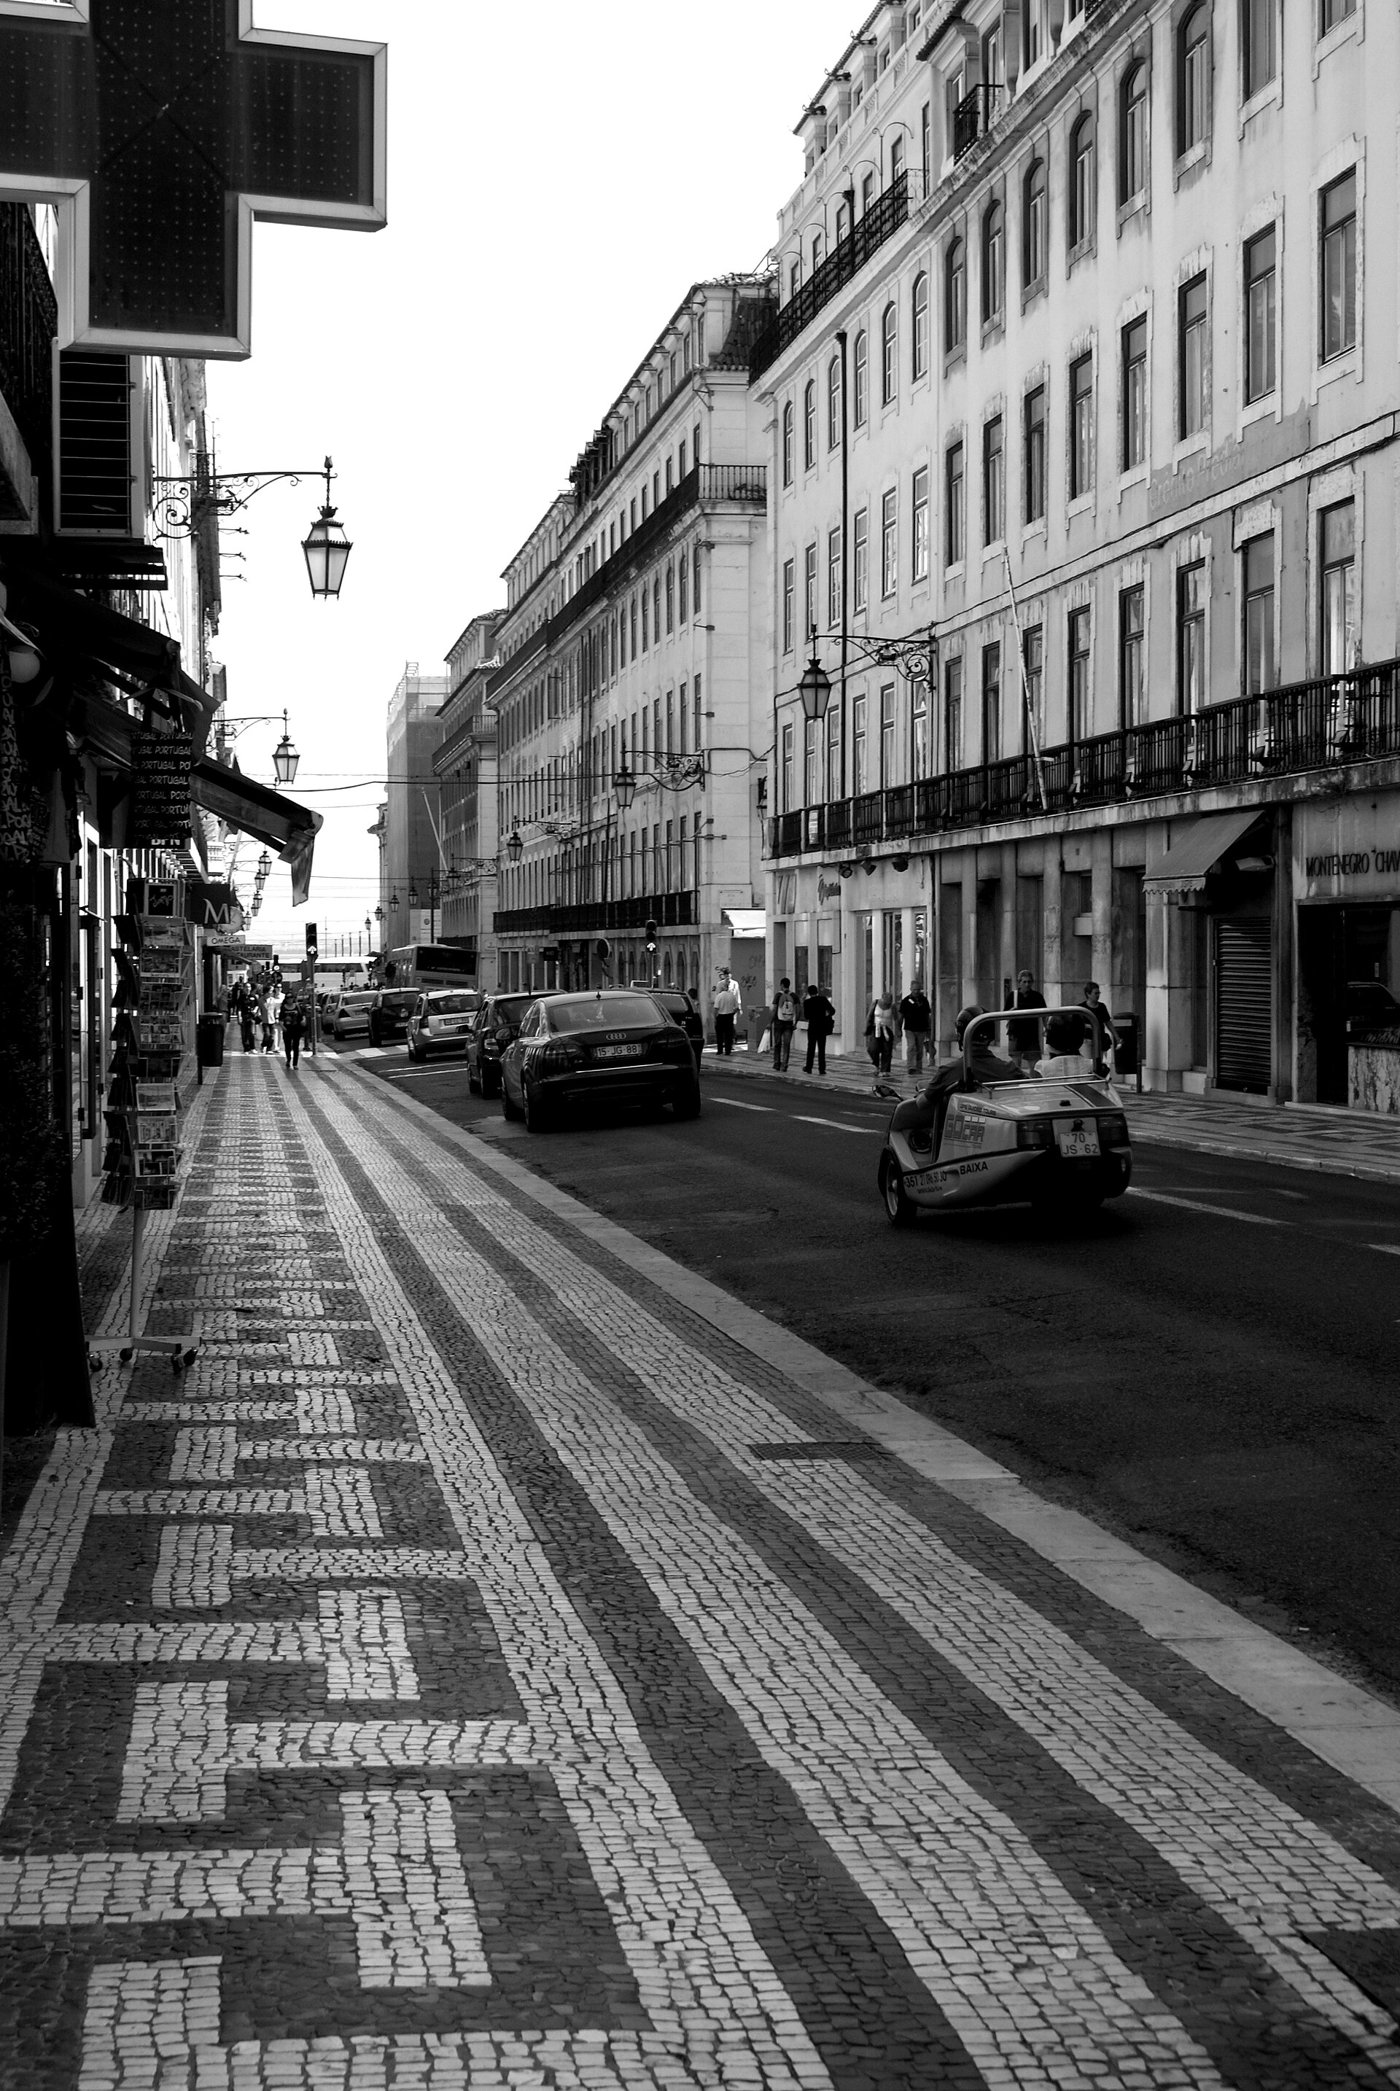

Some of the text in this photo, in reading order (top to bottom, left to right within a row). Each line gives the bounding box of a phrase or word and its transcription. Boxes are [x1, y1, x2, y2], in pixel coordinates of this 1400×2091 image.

[149, 775, 188, 785] PORTUGAL
[1306, 853, 1370, 877] MONTENEGRO
[200, 897, 230, 924] M
[211, 936, 242, 945] OMEGA
[230, 945, 267, 953] ASTELARIA
[1071, 1133, 1086, 1144] 70
[960, 1161, 989, 1175] BAIXA
